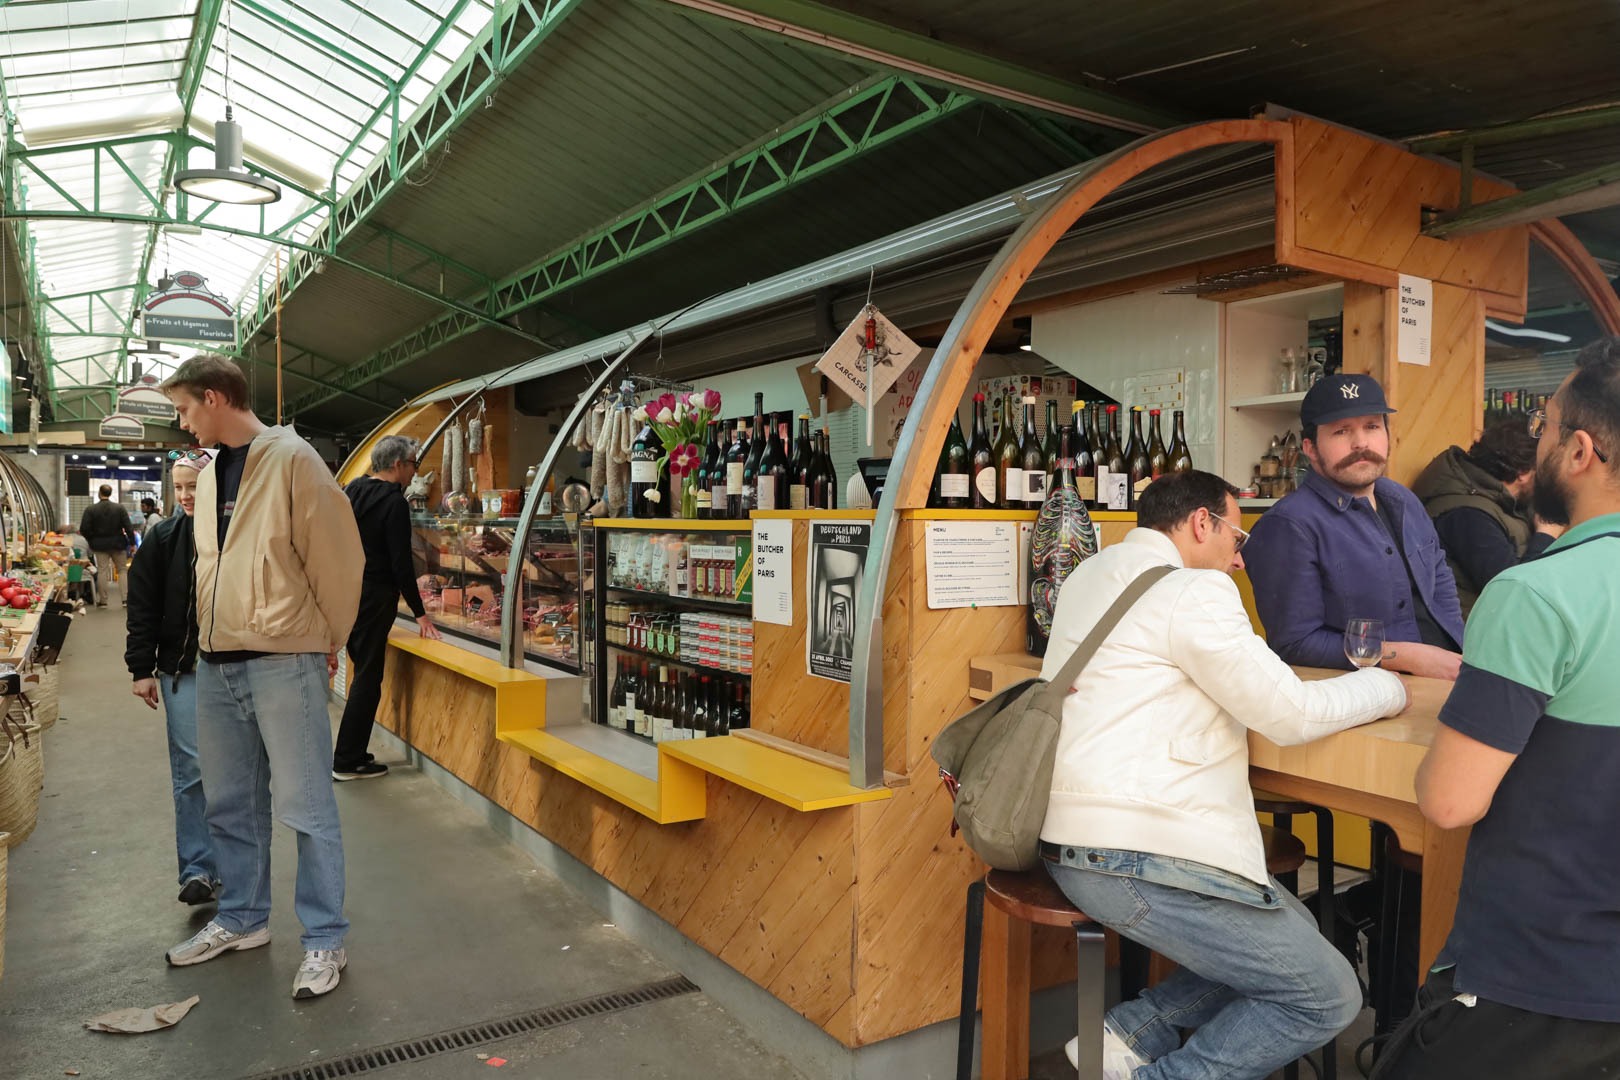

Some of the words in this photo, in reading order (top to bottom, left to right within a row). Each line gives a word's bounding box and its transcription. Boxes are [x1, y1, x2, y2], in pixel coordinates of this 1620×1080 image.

[1402, 297, 1425, 306] BUTCHER
[152, 317, 171, 325] Fruits
[183, 320, 209, 328] légumes
[1402, 317, 1416, 326] PARIS
[199, 329, 227, 337] Fleuriste
[834, 361, 868, 392] CARCASSE
[1340, 382, 1359, 399] NY
[820, 525, 862, 535] DEUTSCHLAND
[835, 535, 851, 543] PARIS
[757, 545, 784, 553] BUTCHER
[757, 557, 765, 565] OF
[757, 569, 775, 578] PARIS
